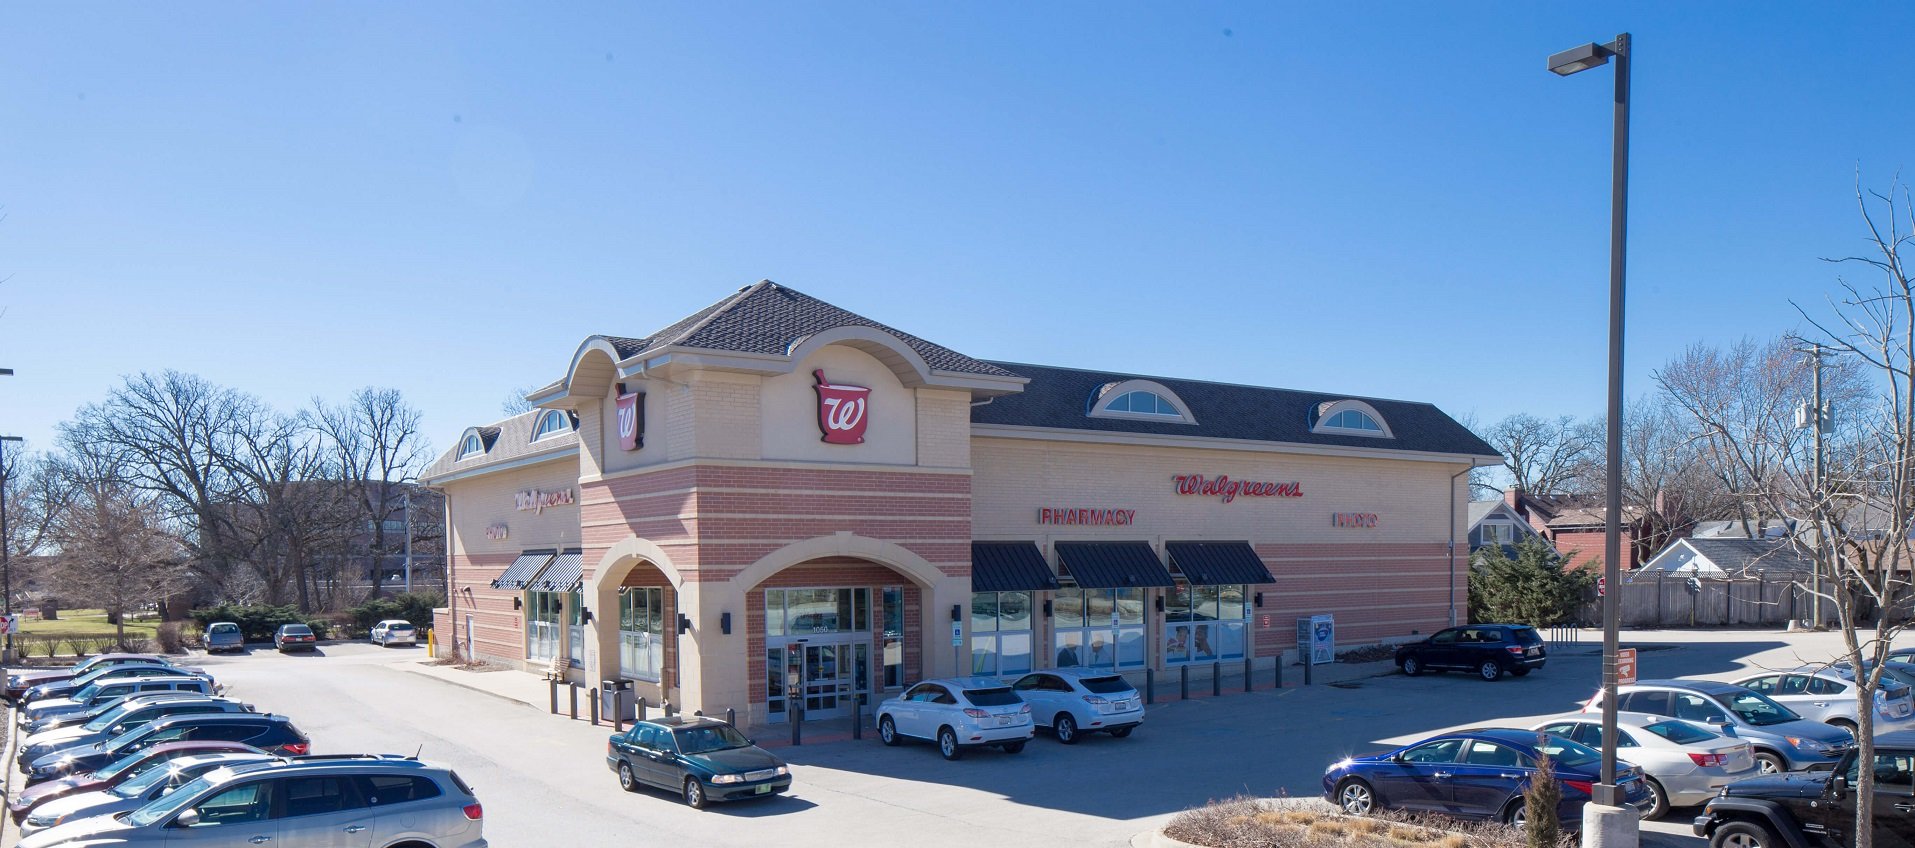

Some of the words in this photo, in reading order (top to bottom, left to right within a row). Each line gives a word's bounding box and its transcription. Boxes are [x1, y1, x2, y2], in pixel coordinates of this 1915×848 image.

[618, 403, 636, 438] W
[824, 398, 864, 431] W
[1173, 475, 1304, 503] Walgreens
[1039, 507, 1136, 525] PHARMACY
